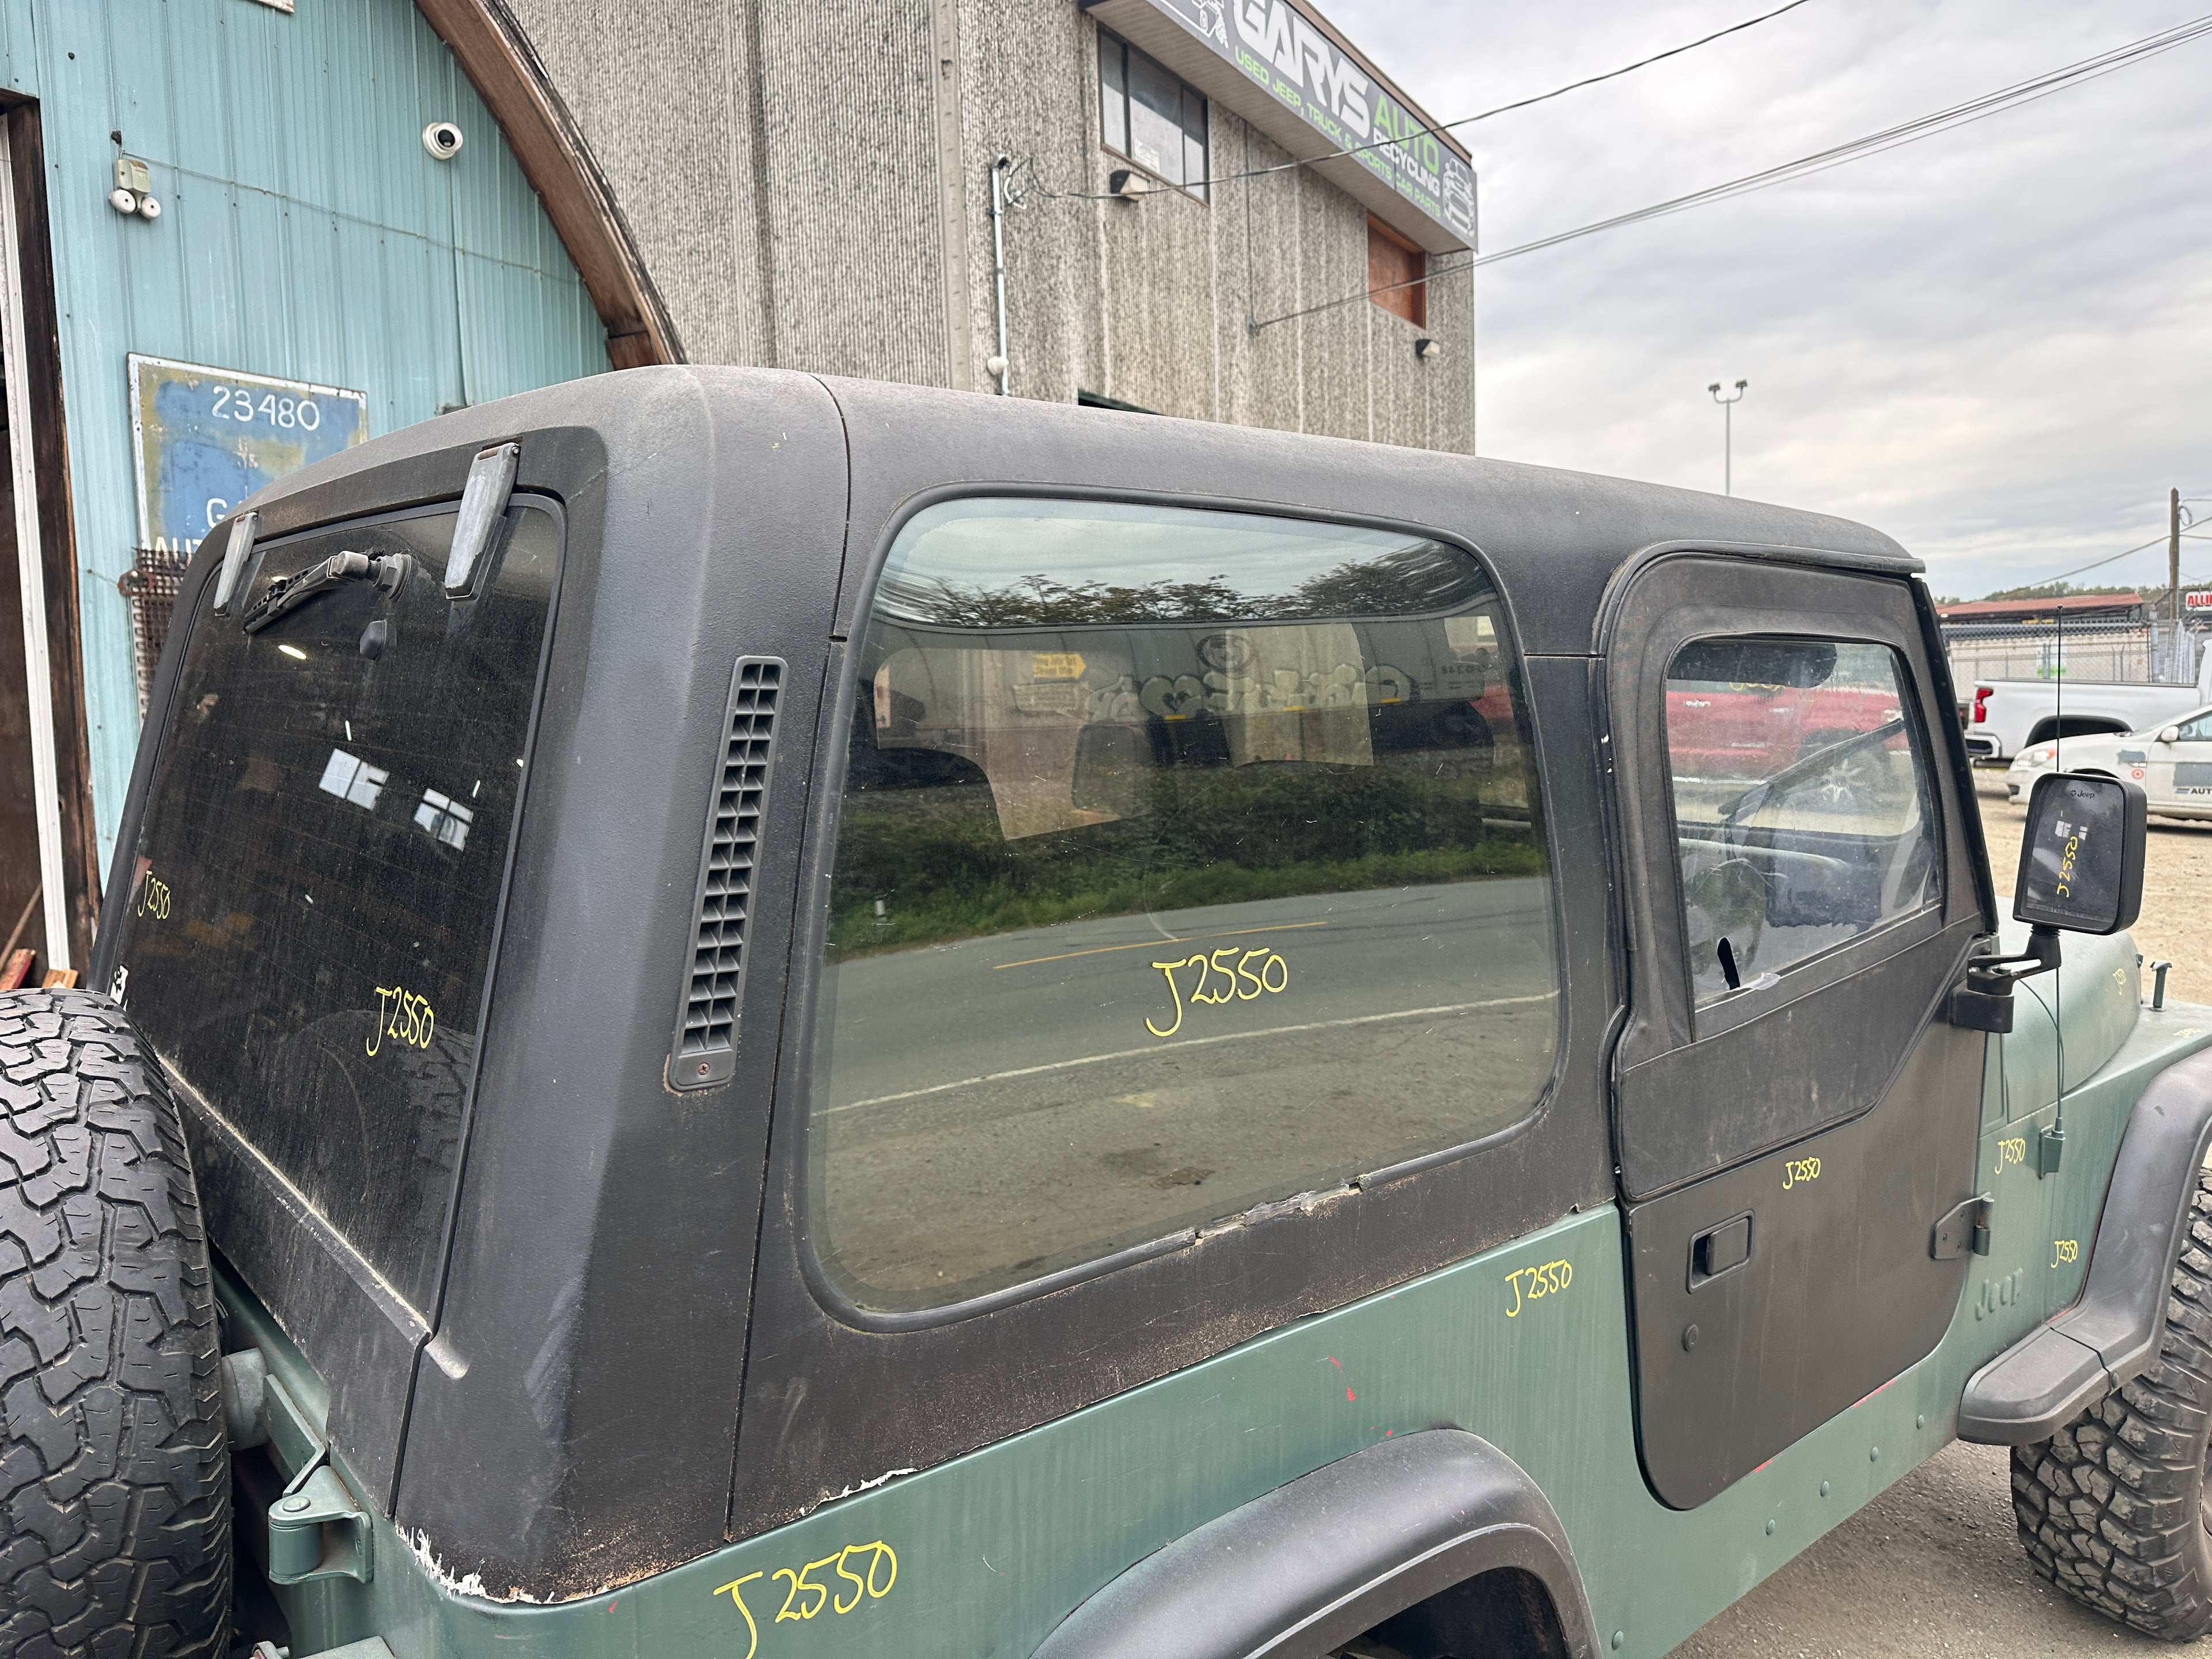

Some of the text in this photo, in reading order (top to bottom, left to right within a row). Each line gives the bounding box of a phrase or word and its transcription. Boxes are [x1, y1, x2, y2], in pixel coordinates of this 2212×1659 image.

[1233, 0, 1370, 139] GARYS
[1234, 45, 1269, 85] USED
[1306, 101, 1342, 142] TRUCK
[1355, 142, 1392, 180] SPORTS
[1396, 172, 1413, 196] CAR
[1414, 188, 1441, 217] PARTS
[1373, 127, 1440, 198] RECYCLING
[1374, 93, 1439, 176] AUTO
[211, 385, 320, 431] 23480
[2077, 790, 2095, 800] Jeep
[138, 870, 171, 920] J2550
[2056, 835, 2078, 898] J2550
[366, 986, 434, 1057] J2550
[1145, 946, 1289, 1037] J2550
[1782, 1156, 1821, 1190] J2550
[1994, 1137, 2026, 1175] J2550
[2051, 1240, 2078, 1268] J2550
[1504, 1258, 1573, 1318] J2550
[713, 1540, 897, 1659] J2550
